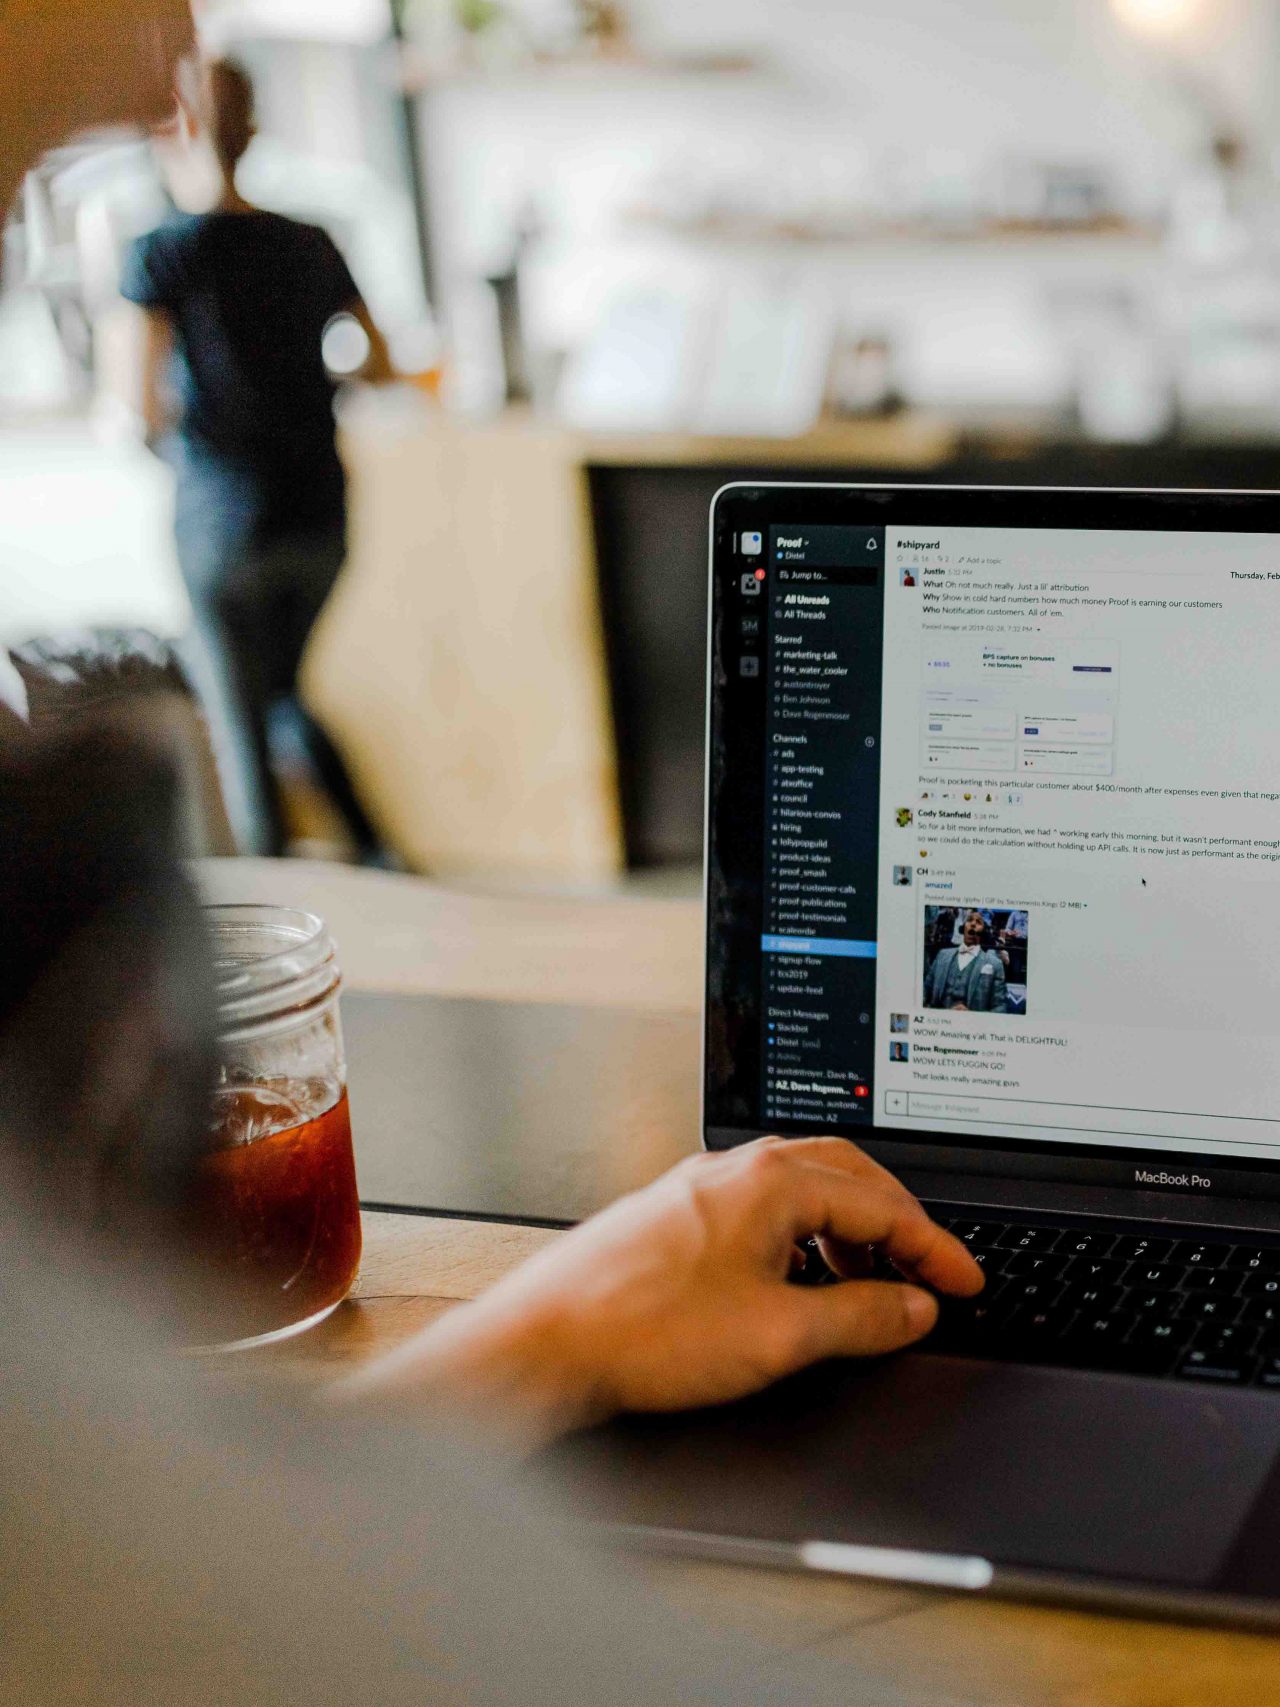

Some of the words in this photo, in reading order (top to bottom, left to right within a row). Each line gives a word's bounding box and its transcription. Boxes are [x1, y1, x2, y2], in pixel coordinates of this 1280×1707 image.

[777, 537, 802, 547] Proof
[897, 540, 940, 550] #shipyard
[792, 571, 811, 580] Jump
[1231, 572, 1265, 580] Thursday,
[1050, 584, 1089, 592] attribution
[785, 595, 796, 604] All
[798, 595, 830, 605] Unreads
[923, 593, 939, 602] Why
[942, 593, 962, 601] Show
[973, 594, 987, 602] cold
[990, 595, 1006, 603] hard
[1008, 595, 1039, 604] numbers
[1042, 596, 1057, 604] how
[1082, 598, 1106, 606] money
[1108, 597, 1129, 606] Proof
[1139, 599, 1167, 608] earning
[1184, 601, 1222, 609] customers
[784, 610, 794, 618] All
[796, 611, 826, 619] Threads
[942, 607, 984, 615] Notification
[775, 635, 802, 644] Starred
[783, 651, 837, 661] marketing-talk
[783, 665, 848, 676] the_water_cooler
[773, 734, 807, 743] Channels
[918, 776, 938, 784] Proof
[948, 778, 982, 787] pocketing
[984, 778, 998, 786] this
[1000, 780, 1033, 788] particular
[1036, 782, 1069, 790] customer
[1095, 783, 1142, 794] $400/month
[1144, 786, 1162, 794] after
[1221, 790, 1241, 799] given
[1244, 790, 1258, 799] that
[918, 810, 936, 818] Cody
[938, 810, 971, 819] Stanfield
[947, 823, 956, 831] bit
[979, 826, 1022, 834] information,
[1038, 827, 1051, 835] had
[1060, 830, 1089, 839] working
[1091, 831, 1109, 840] early
[1162, 834, 1173, 842] but
[1209, 837, 1252, 846] performant
[987, 839, 1025, 847] calculation
[1027, 840, 1055, 849] without
[1058, 843, 1084, 852] holding
[1166, 848, 1179, 856] just
[1192, 849, 1234, 858] performant
[940, 1030, 971, 1040] Amazing
[990, 1034, 1006, 1042] That
[934, 1046, 978, 1056] Rogenmoser
[913, 1057, 935, 1065] WOW
[937, 1058, 956, 1067] LETS
[913, 1072, 929, 1080] That
[952, 1075, 969, 1084] really
[972, 1077, 1001, 1087] amazing
[1135, 1170, 1189, 1187] MacBook
[1191, 1176, 1211, 1188] Pro
